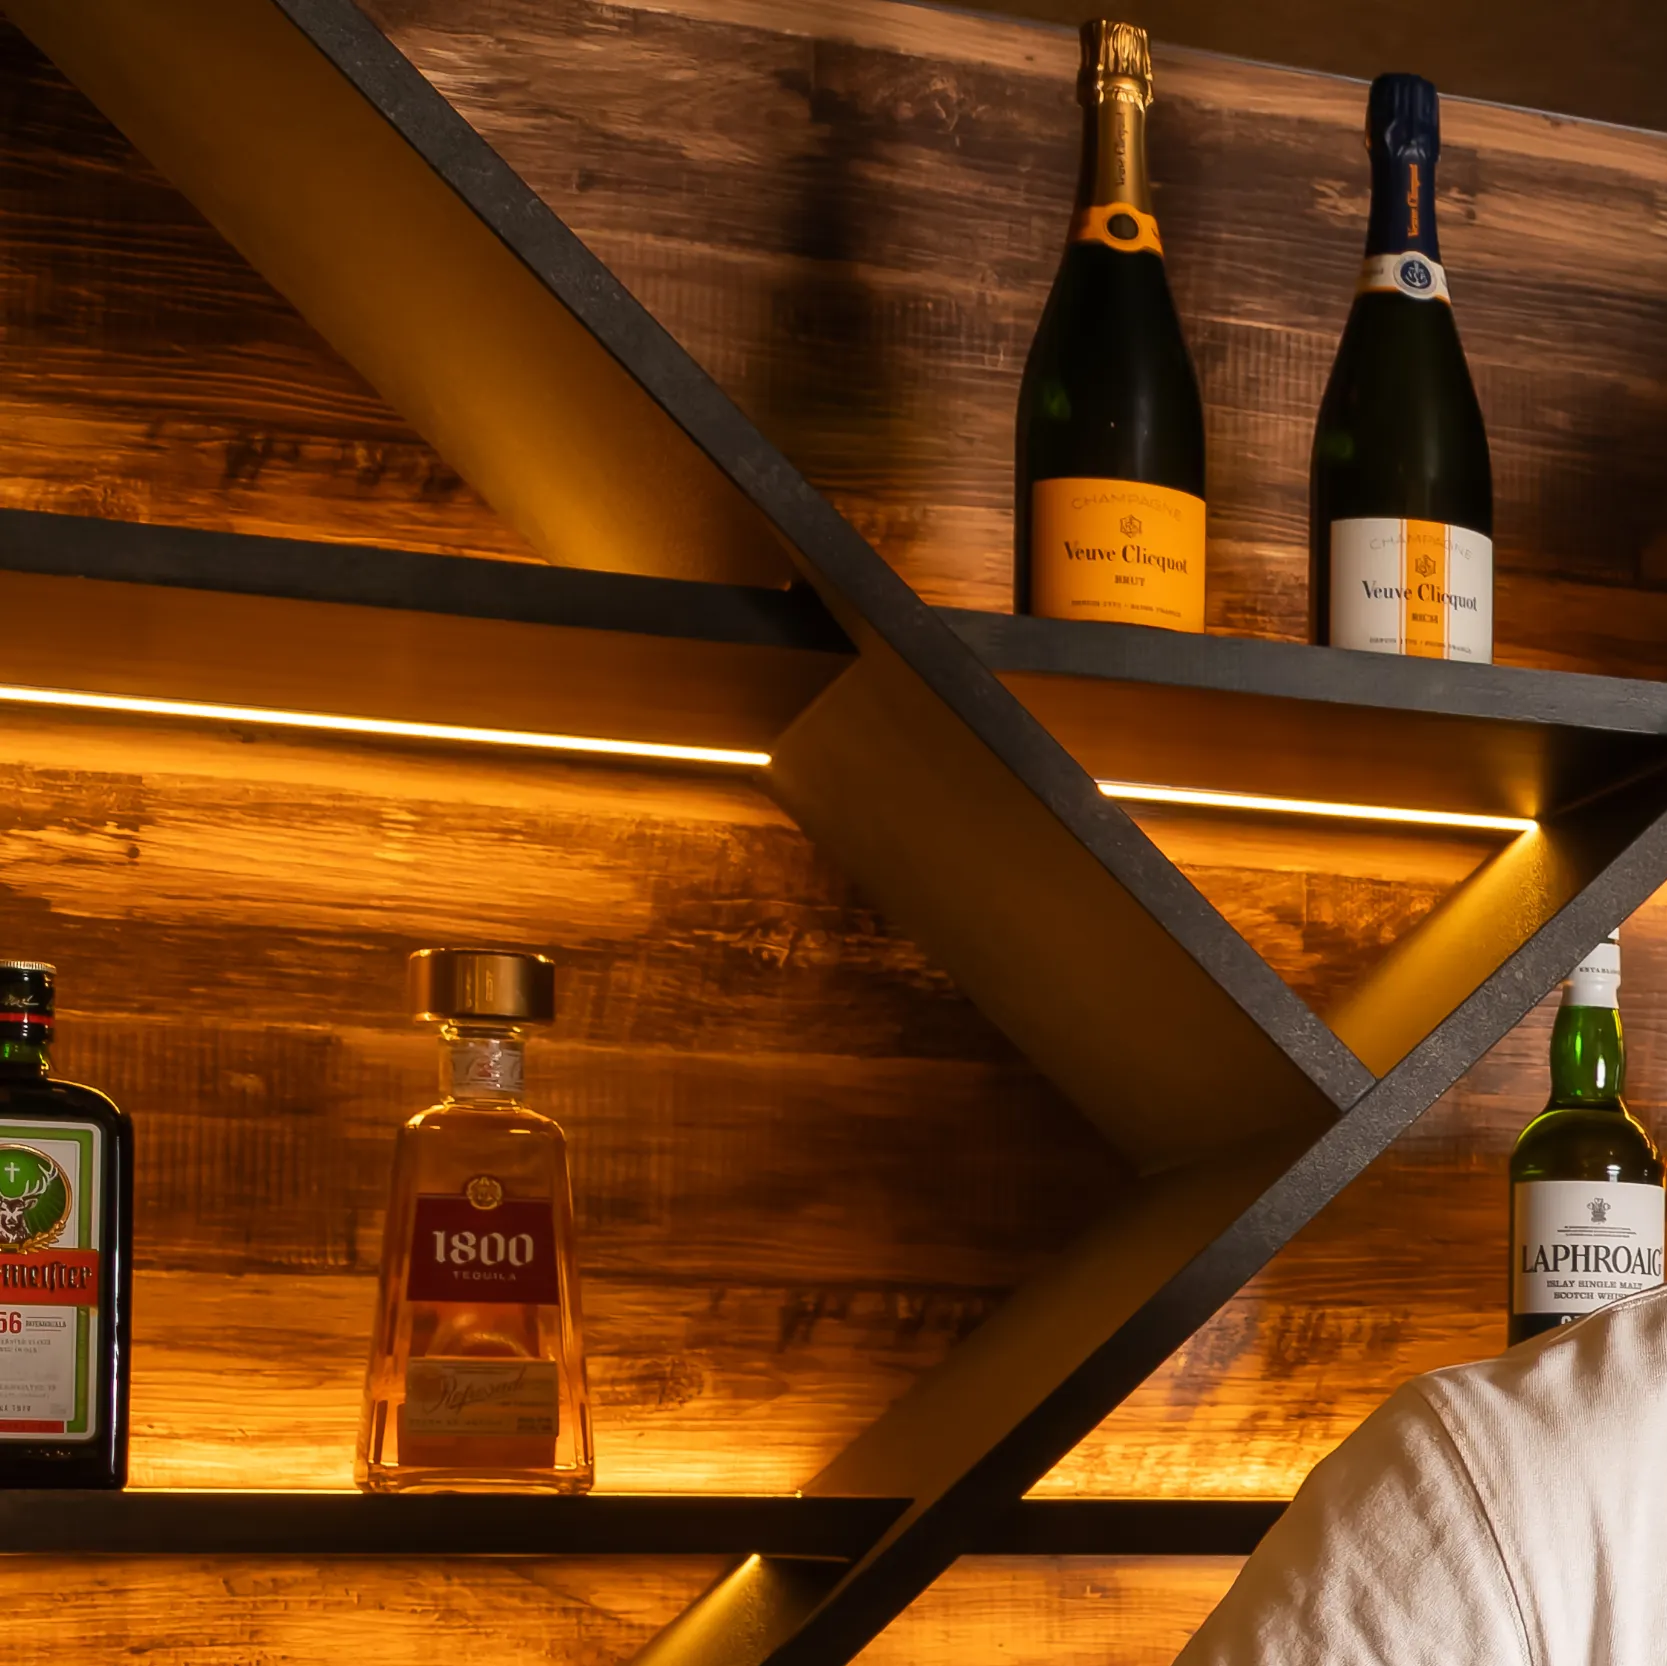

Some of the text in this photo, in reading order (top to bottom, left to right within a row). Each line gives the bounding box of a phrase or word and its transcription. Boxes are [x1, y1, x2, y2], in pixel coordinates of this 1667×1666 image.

[1071, 493, 1182, 522] CHAMPAGNE
[1064, 540, 1188, 574] Veuve Clicquot
[1369, 534, 1473, 560] CHAMPAGNE
[1362, 580, 1478, 612] Veuve Clicquot
[432, 1231, 534, 1266] 1800
[1522, 1244, 1662, 1277] LAPHROAIG
[453, 1271, 517, 1281] TEQUILA
[1547, 1280, 1643, 1290] ISLAY SINGLE MALT
[1554, 1291, 1594, 1299] SCOTCH
